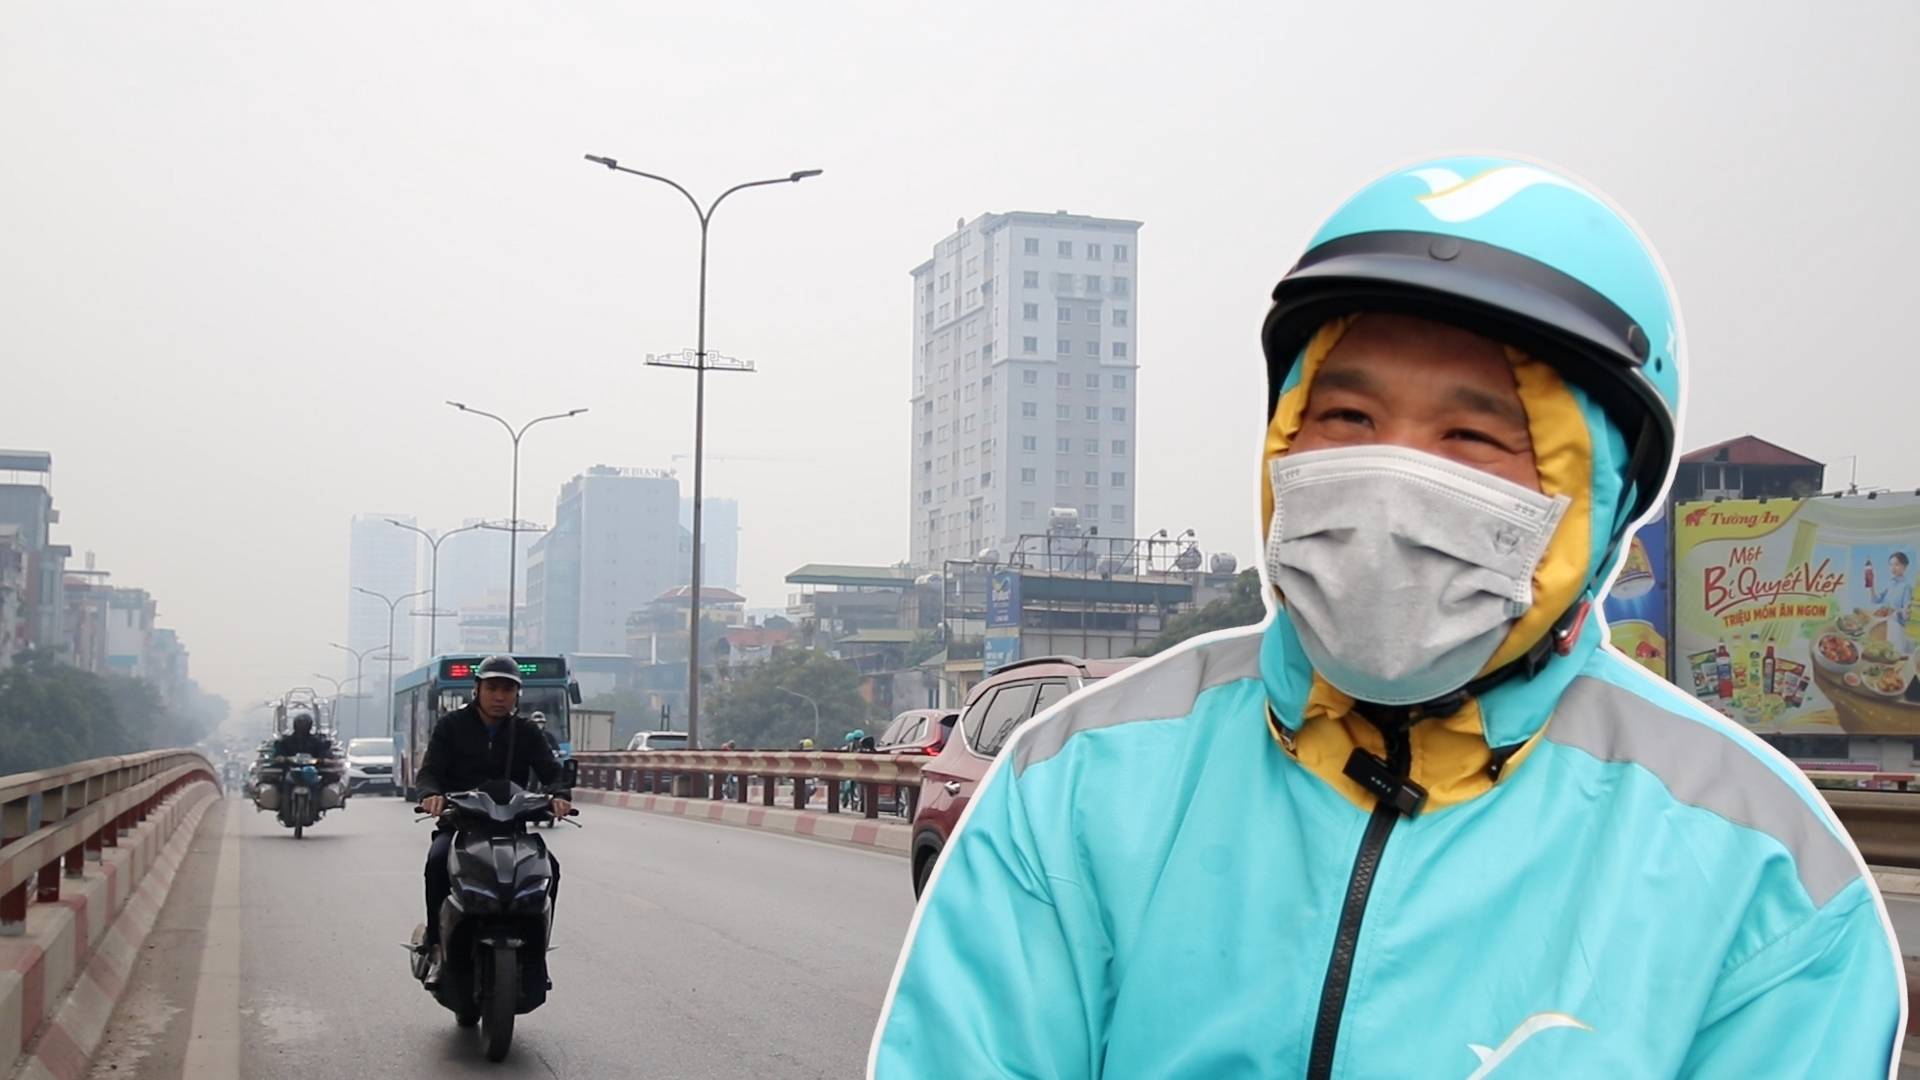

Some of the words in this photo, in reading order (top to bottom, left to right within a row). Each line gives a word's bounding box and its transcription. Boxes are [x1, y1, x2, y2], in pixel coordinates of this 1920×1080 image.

[1729, 545, 1764, 568] Một
[1704, 565, 1735, 611] Bí
[1737, 565, 1802, 605] Quyết
[1804, 557, 1845, 597] Việt
[1722, 608, 1752, 628] TRIỆU
[1753, 604, 1777, 621] MÓN
[1796, 605, 1828, 617] NGON
